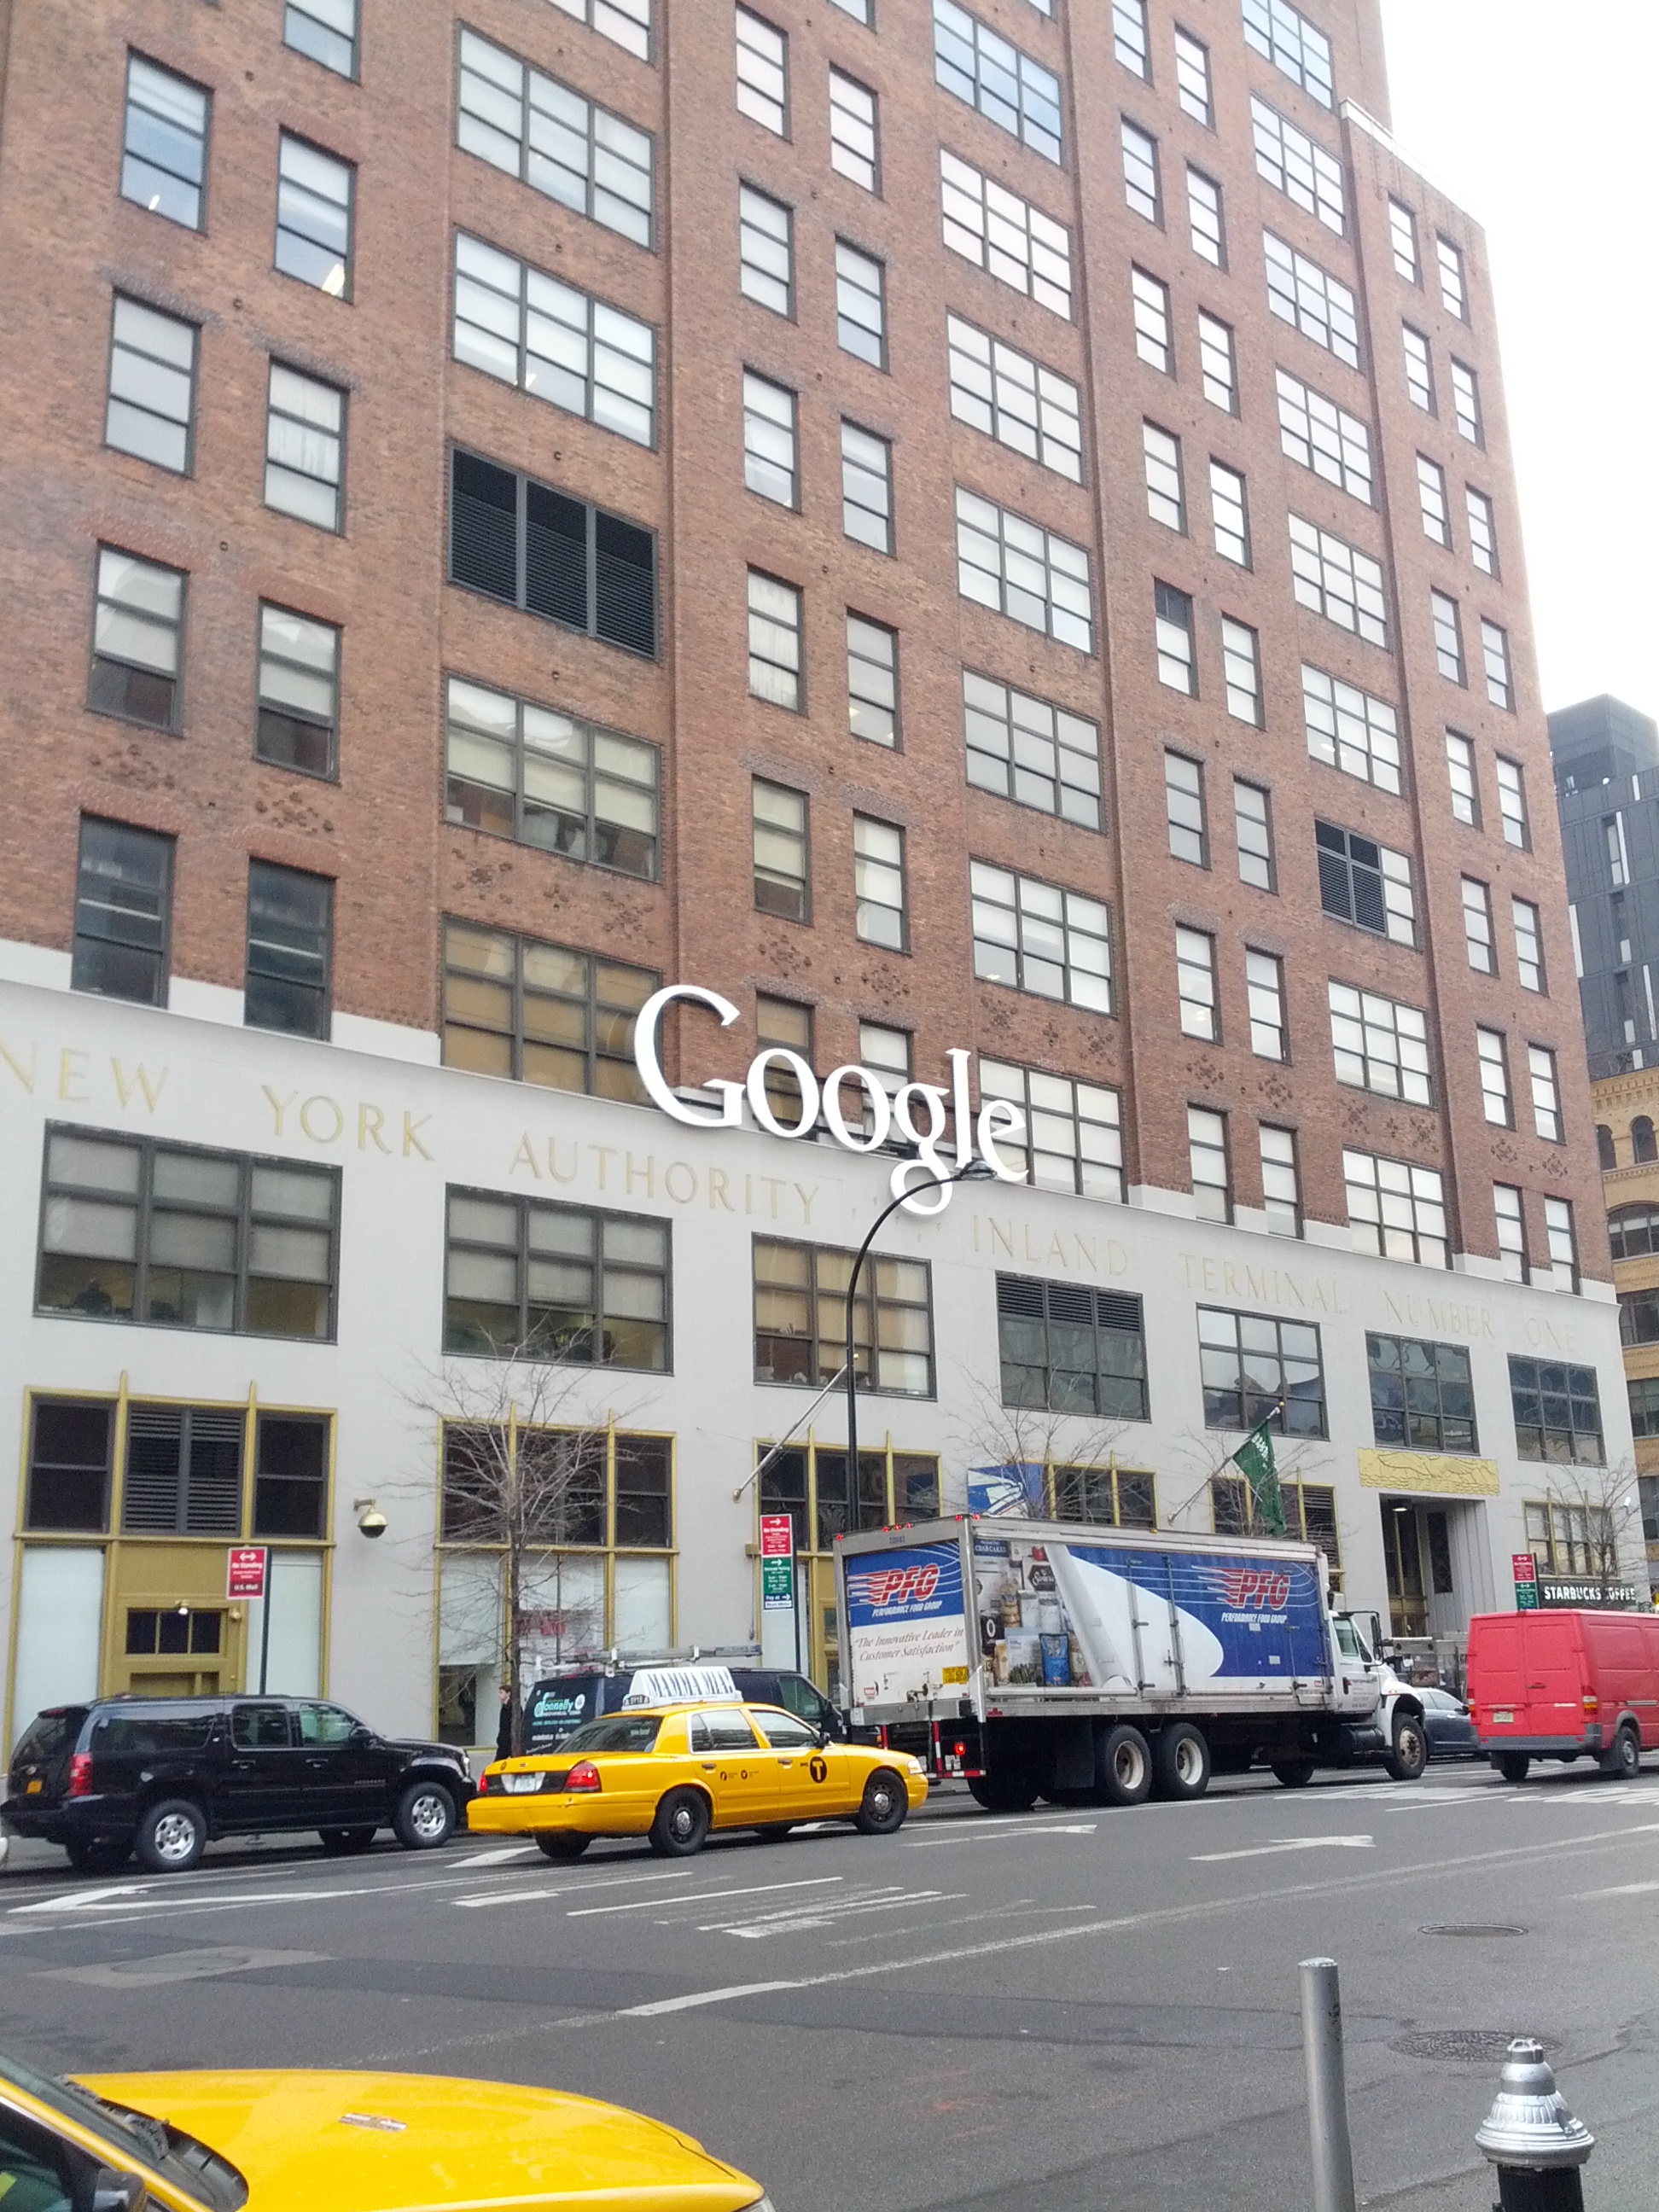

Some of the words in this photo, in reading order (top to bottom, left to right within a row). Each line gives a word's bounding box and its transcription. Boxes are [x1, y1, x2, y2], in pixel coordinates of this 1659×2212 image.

[634, 985, 1029, 1215] Google
[0, 1034, 169, 1115] NEW
[261, 1084, 435, 1161] YORK
[509, 1132, 819, 1225] AUTHORITY
[973, 1214, 1128, 1276] INLAND
[1179, 1252, 1347, 1315] TERMINAL
[1382, 1289, 1497, 1341] NUMBER
[1525, 1317, 1579, 1354] ONE
[1544, 1586, 1602, 1601] STARBUCKS
[1604, 1586, 1637, 1601] OFFEE
[872, 1604, 911, 1618] PERFORMANCE
[1221, 1611, 1258, 1623] PERFORMANCE
[875, 1631, 922, 1647] Innovative
[922, 1627, 953, 1641] Leader
[953, 1626, 964, 1637] in
[859, 1648, 901, 1662] Customer
[646, 1672, 703, 1698] MAMMA
[812, 1761, 825, 1781] T
